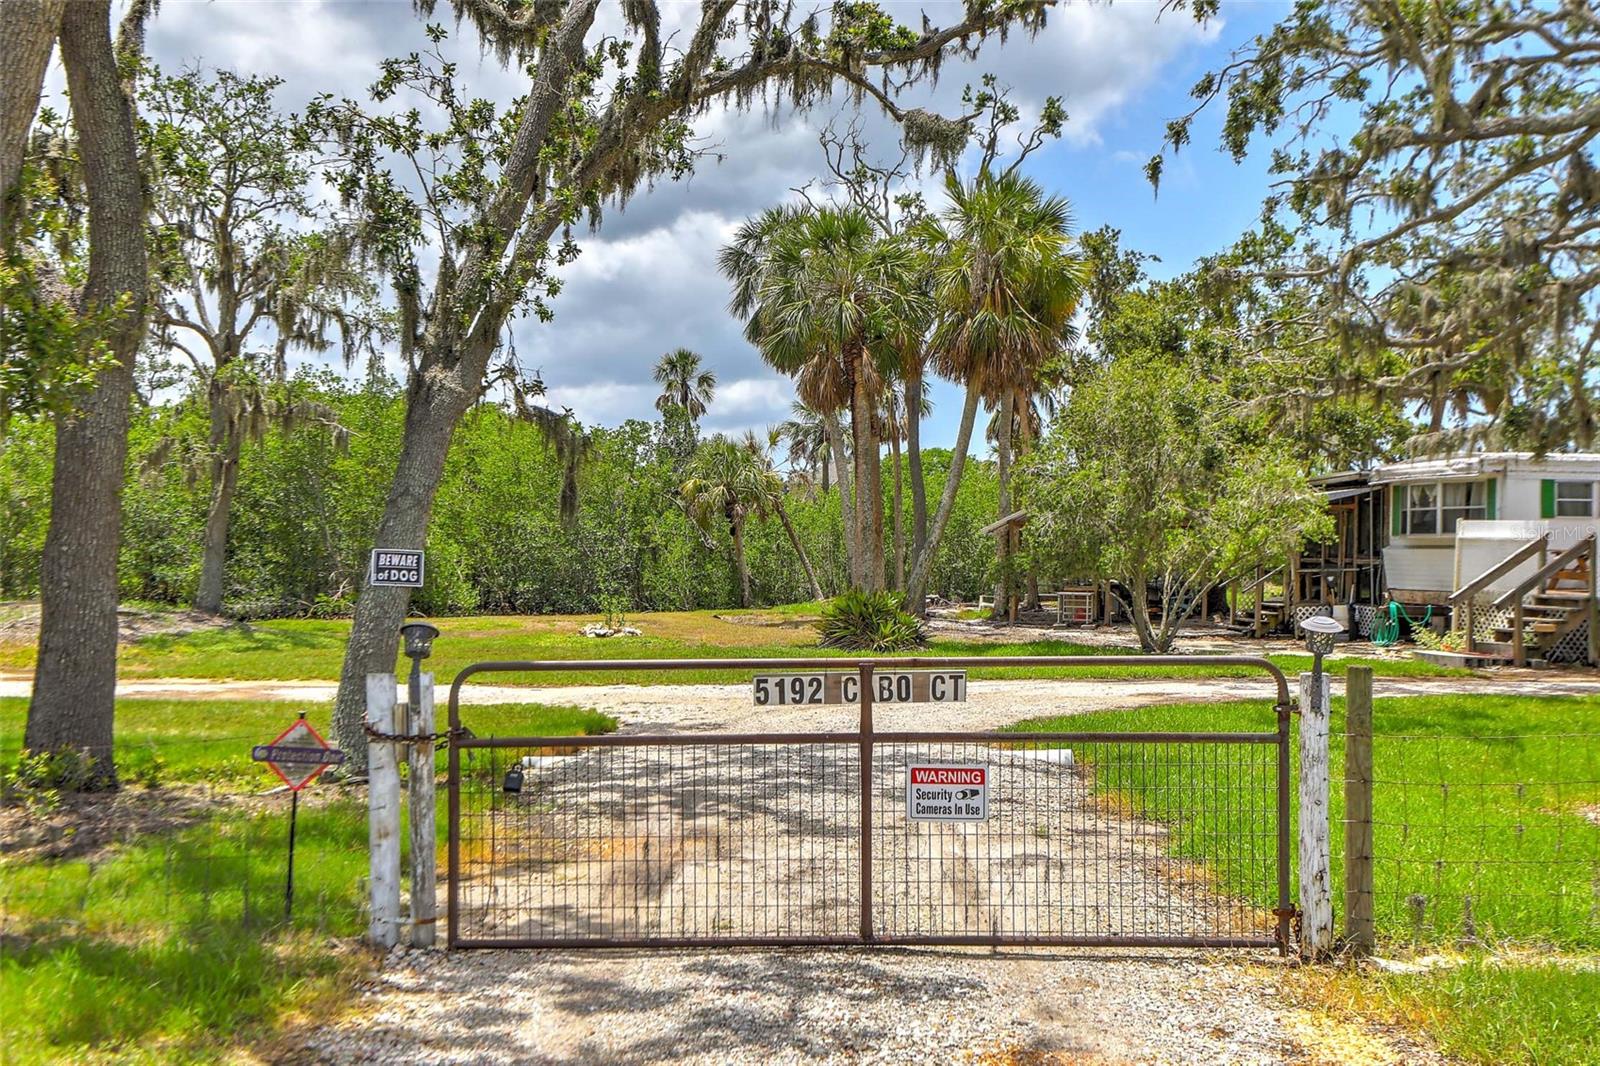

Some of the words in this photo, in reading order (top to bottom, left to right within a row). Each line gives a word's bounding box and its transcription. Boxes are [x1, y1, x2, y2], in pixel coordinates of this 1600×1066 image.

[378, 553, 419, 567] BEWARE
[377, 570, 389, 580] of
[390, 570, 418, 581] DOG
[755, 677, 823, 706] 5192
[843, 675, 911, 703] CBO
[931, 674, 964, 701] CT
[915, 769, 982, 784] WARNING
[916, 788, 953, 803] Security
[916, 802, 952, 815] Cameras
[954, 803, 963, 815] In
[965, 803, 980, 815] Use
